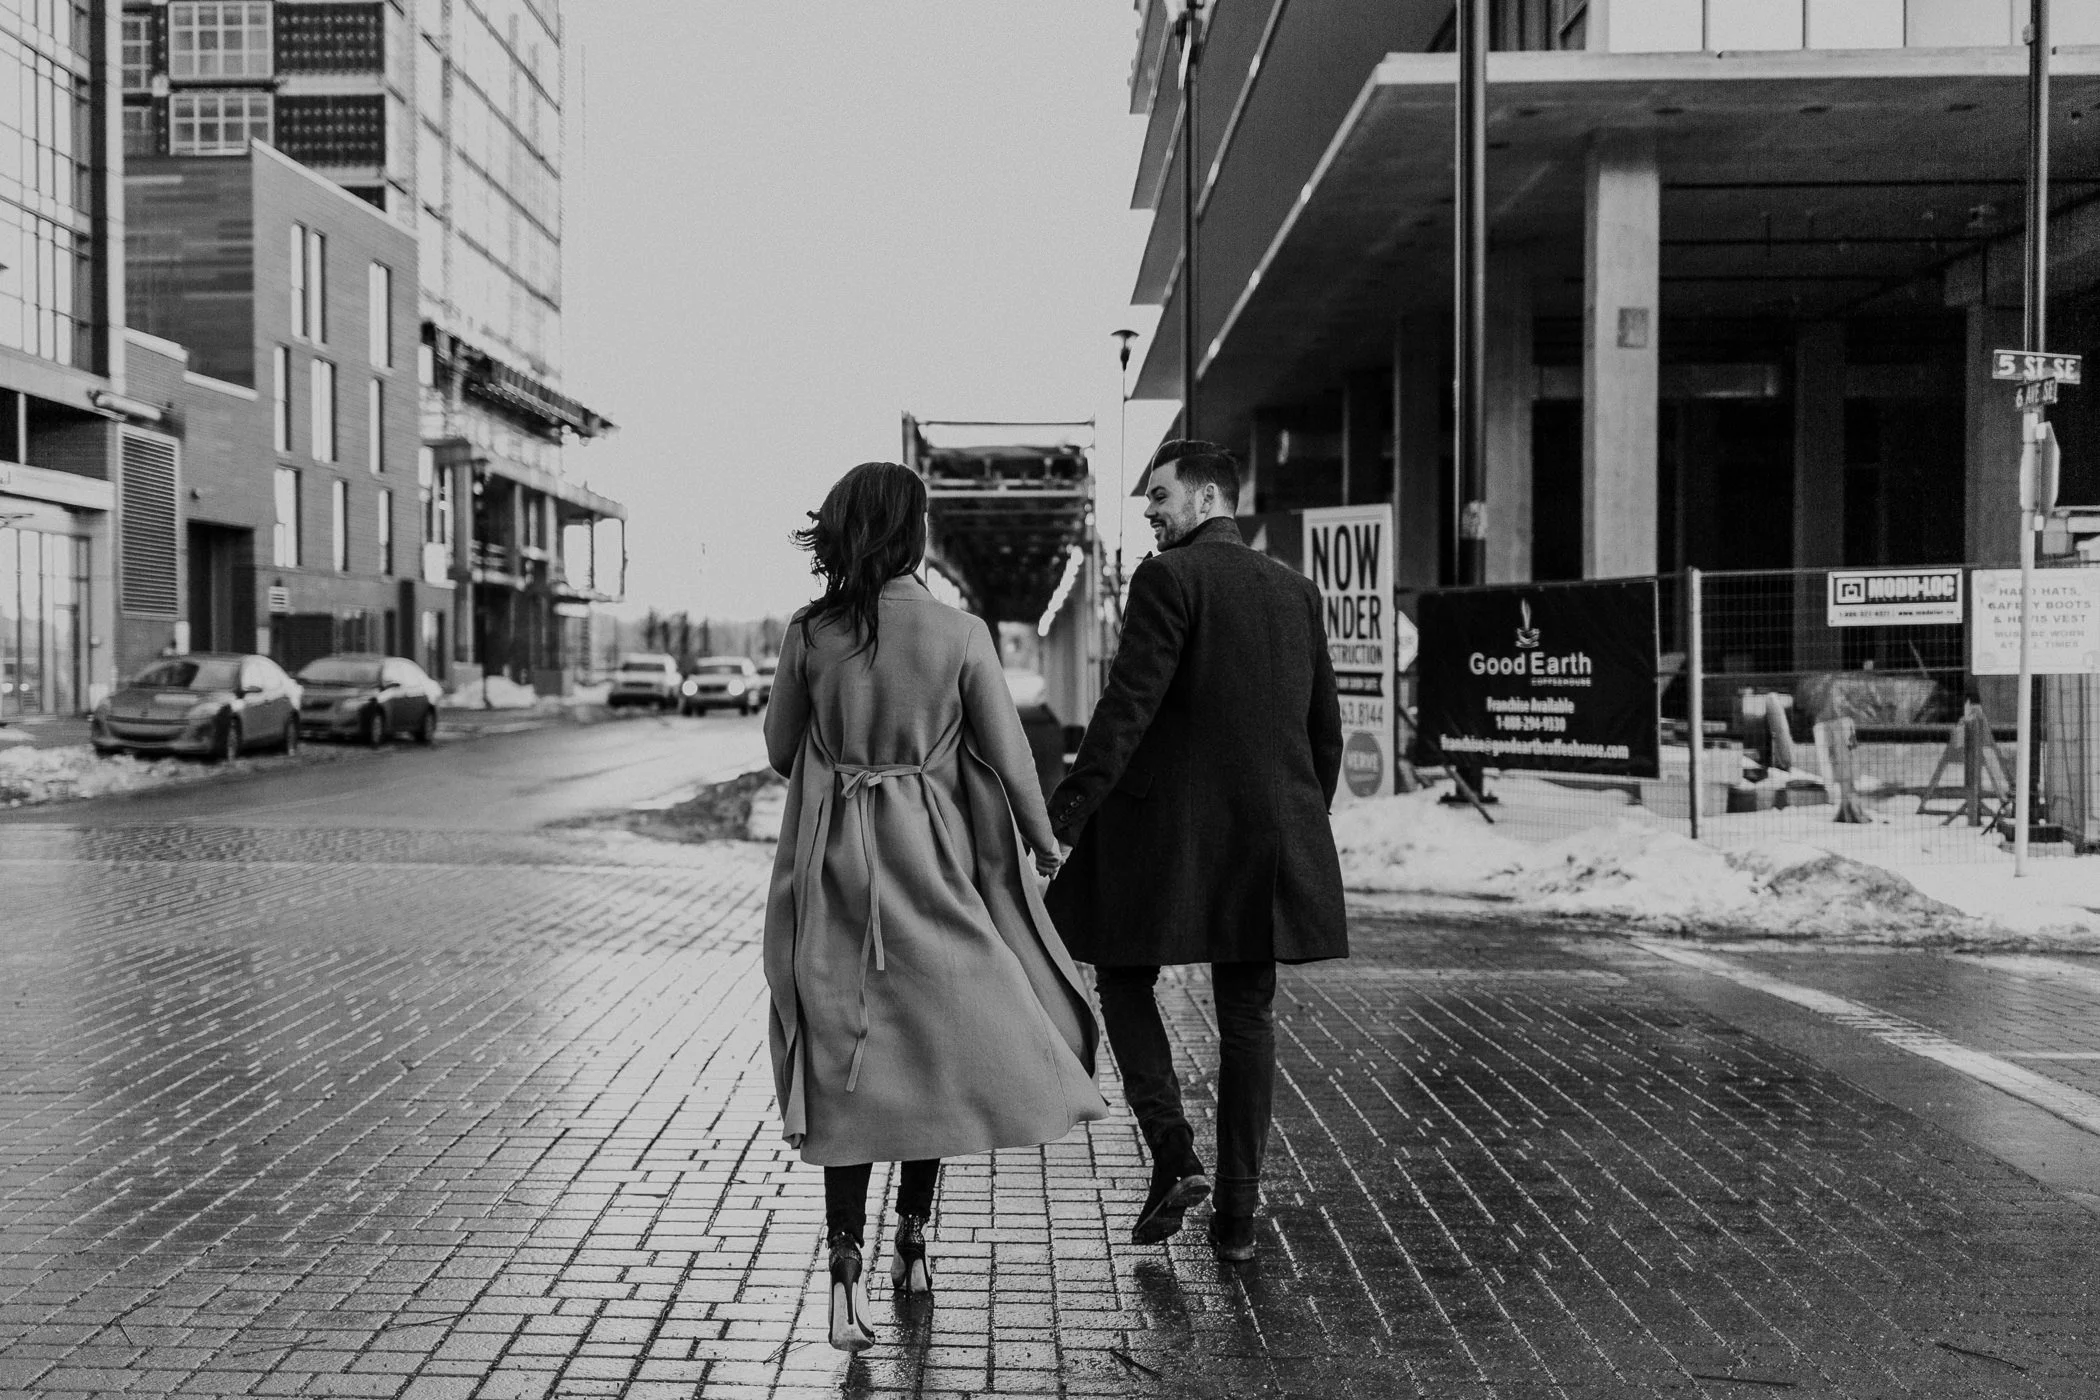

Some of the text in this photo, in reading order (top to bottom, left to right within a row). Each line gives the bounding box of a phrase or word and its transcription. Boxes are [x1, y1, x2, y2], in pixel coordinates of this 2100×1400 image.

[1998, 354, 2077, 380] 5 ST SE
[2016, 387, 2024, 408] 6
[1312, 524, 1381, 591] NOW
[1868, 575, 1955, 599] MODU-LOC
[1987, 600, 2092, 611] SAFEY BOOTS
[1321, 595, 1382, 640] NDER
[2053, 614, 2087, 624] VEST
[1327, 644, 1383, 664] STRUCTION
[1469, 651, 1592, 675] Good Earth
[1486, 695, 1575, 714] Franchise Available
